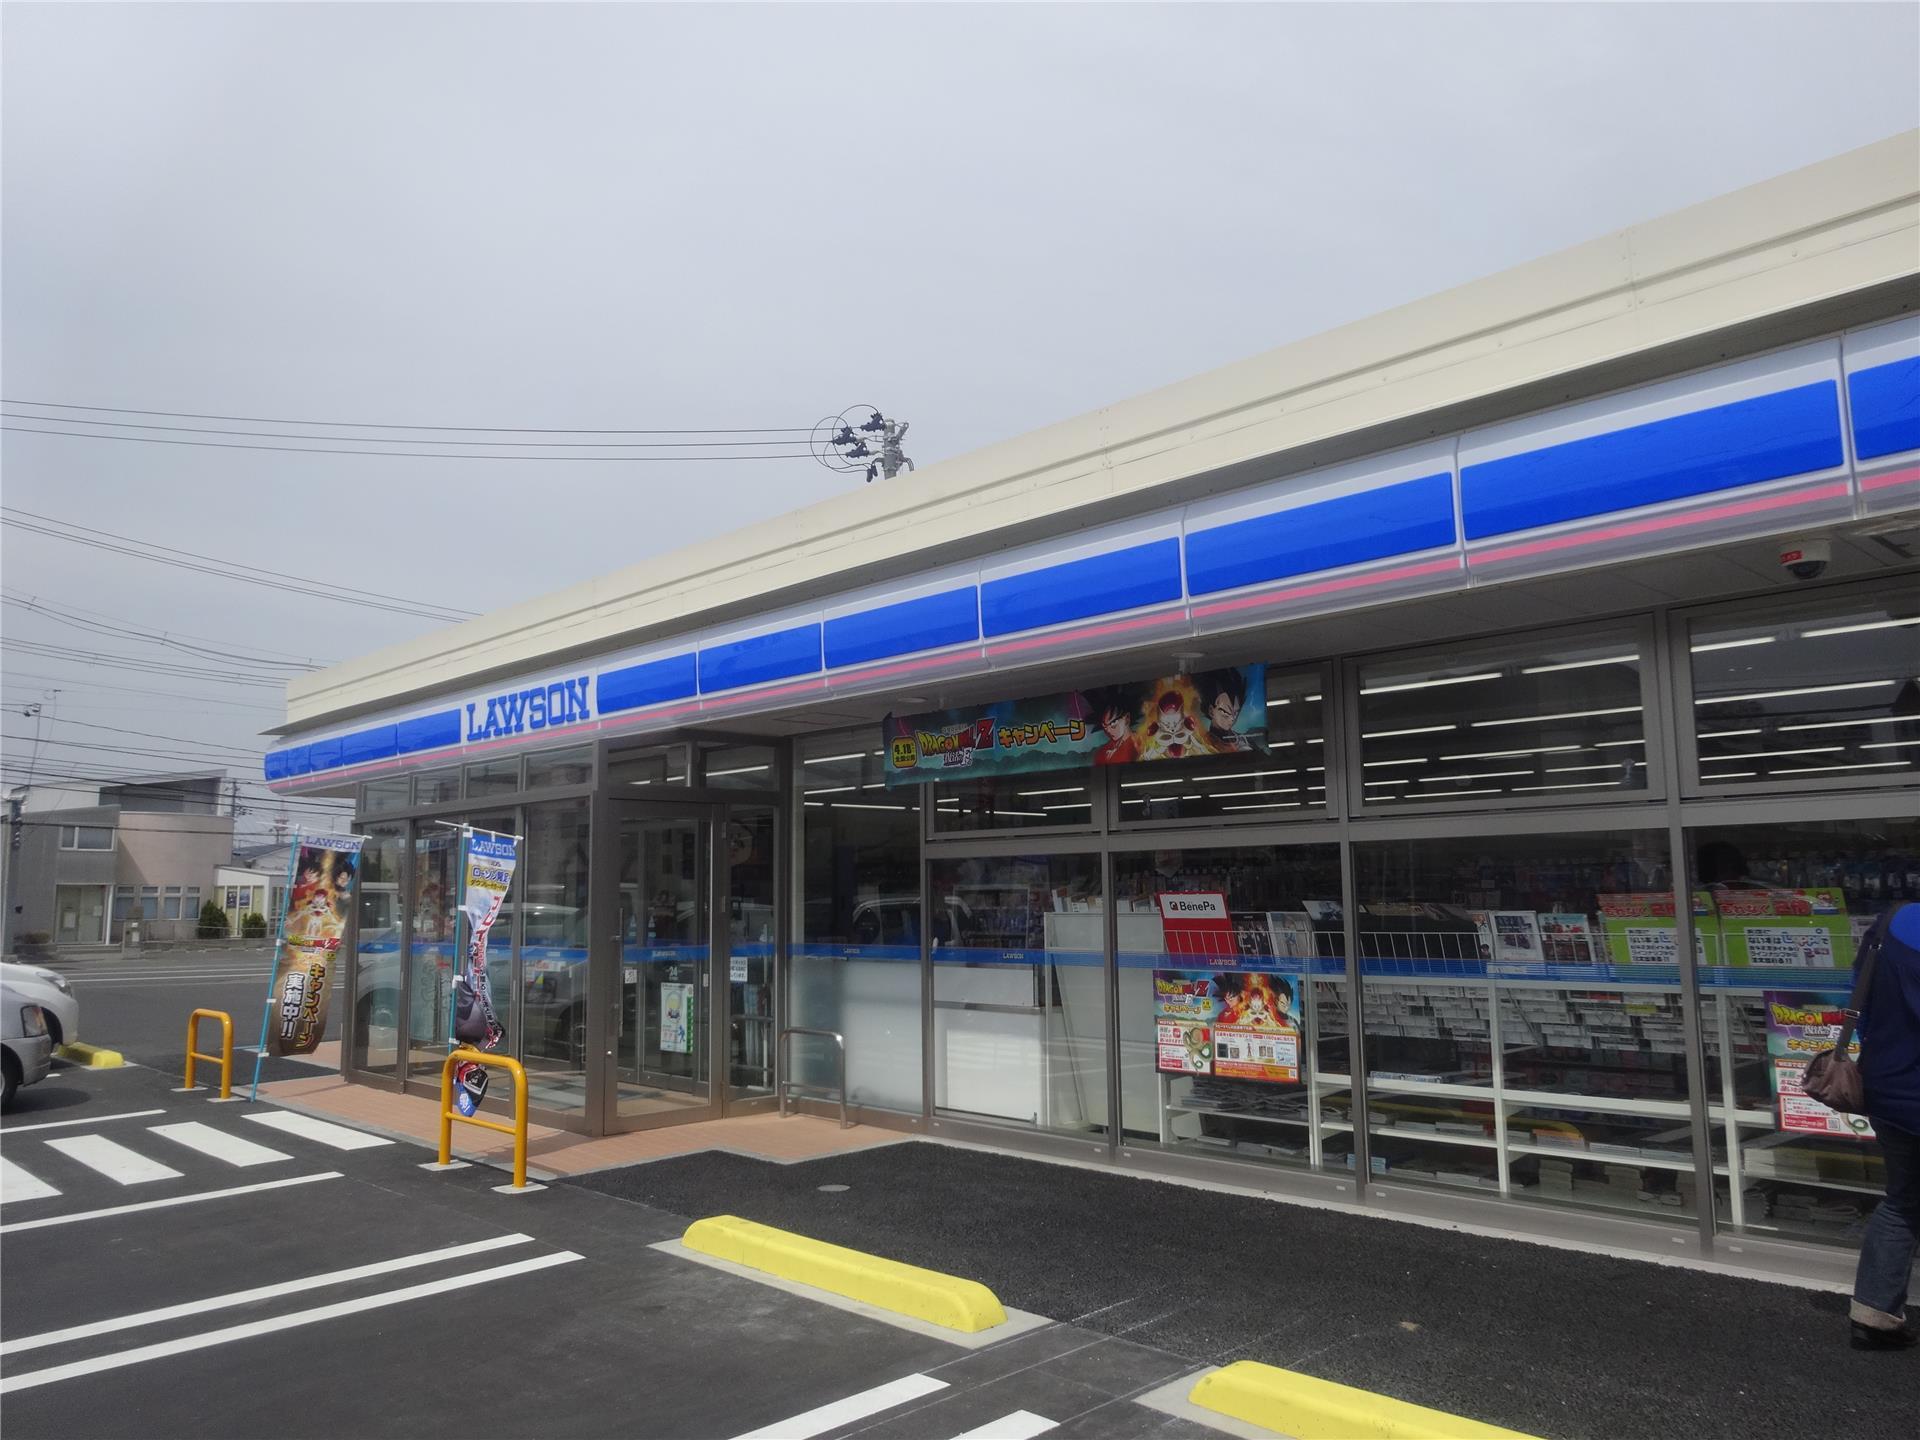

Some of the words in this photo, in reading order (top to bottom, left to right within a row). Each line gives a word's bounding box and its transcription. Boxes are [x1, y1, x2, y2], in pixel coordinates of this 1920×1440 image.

[467, 676, 590, 741] LAWSON
[917, 731, 959, 756] DRAGON
[999, 720, 1085, 747] キャンペーン
[305, 836, 361, 850] LAWSON
[1180, 901, 1215, 911] BenePa
[1209, 958, 1237, 966] LAWSON
[281, 974, 304, 1039] 実施中!!
[296, 963, 326, 1047] キャンペーン
[1769, 1004, 1823, 1026] DRAGON
[1786, 1039, 1861, 1054] キャンペン
